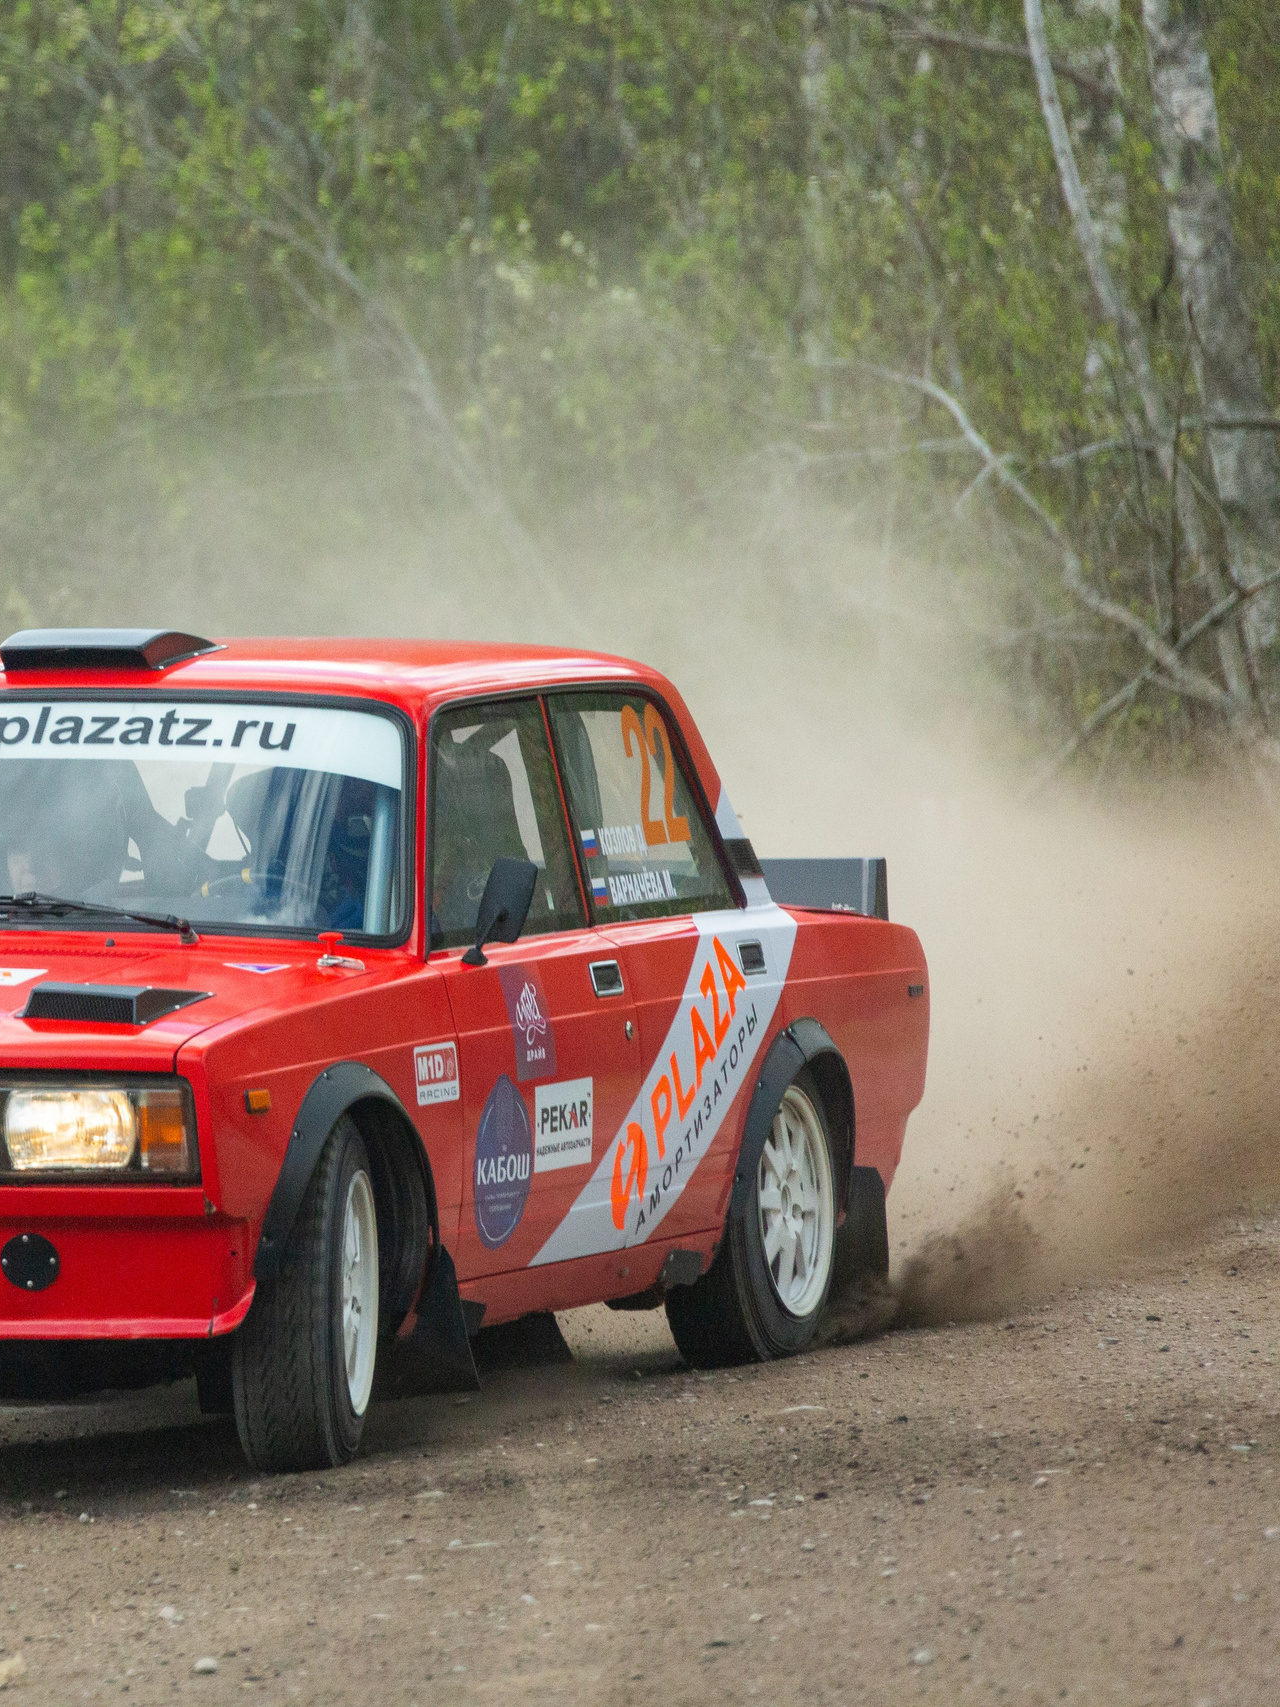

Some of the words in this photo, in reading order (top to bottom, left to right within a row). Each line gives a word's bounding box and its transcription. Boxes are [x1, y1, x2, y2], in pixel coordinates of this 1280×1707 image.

[621, 702, 691, 847] 22
[597, 825, 637, 856] КОЗЛОВ
[526, 1046, 546, 1062] ДРАЙВ
[650, 935, 746, 1161] PLAZA
[417, 1054, 444, 1082] M1D
[420, 1086, 457, 1100] RACING
[541, 1100, 588, 1135] PEKAR
[635, 1003, 758, 1236] АМОРТИЗАТОРЫ
[477, 1153, 530, 1186] КАБОШ
